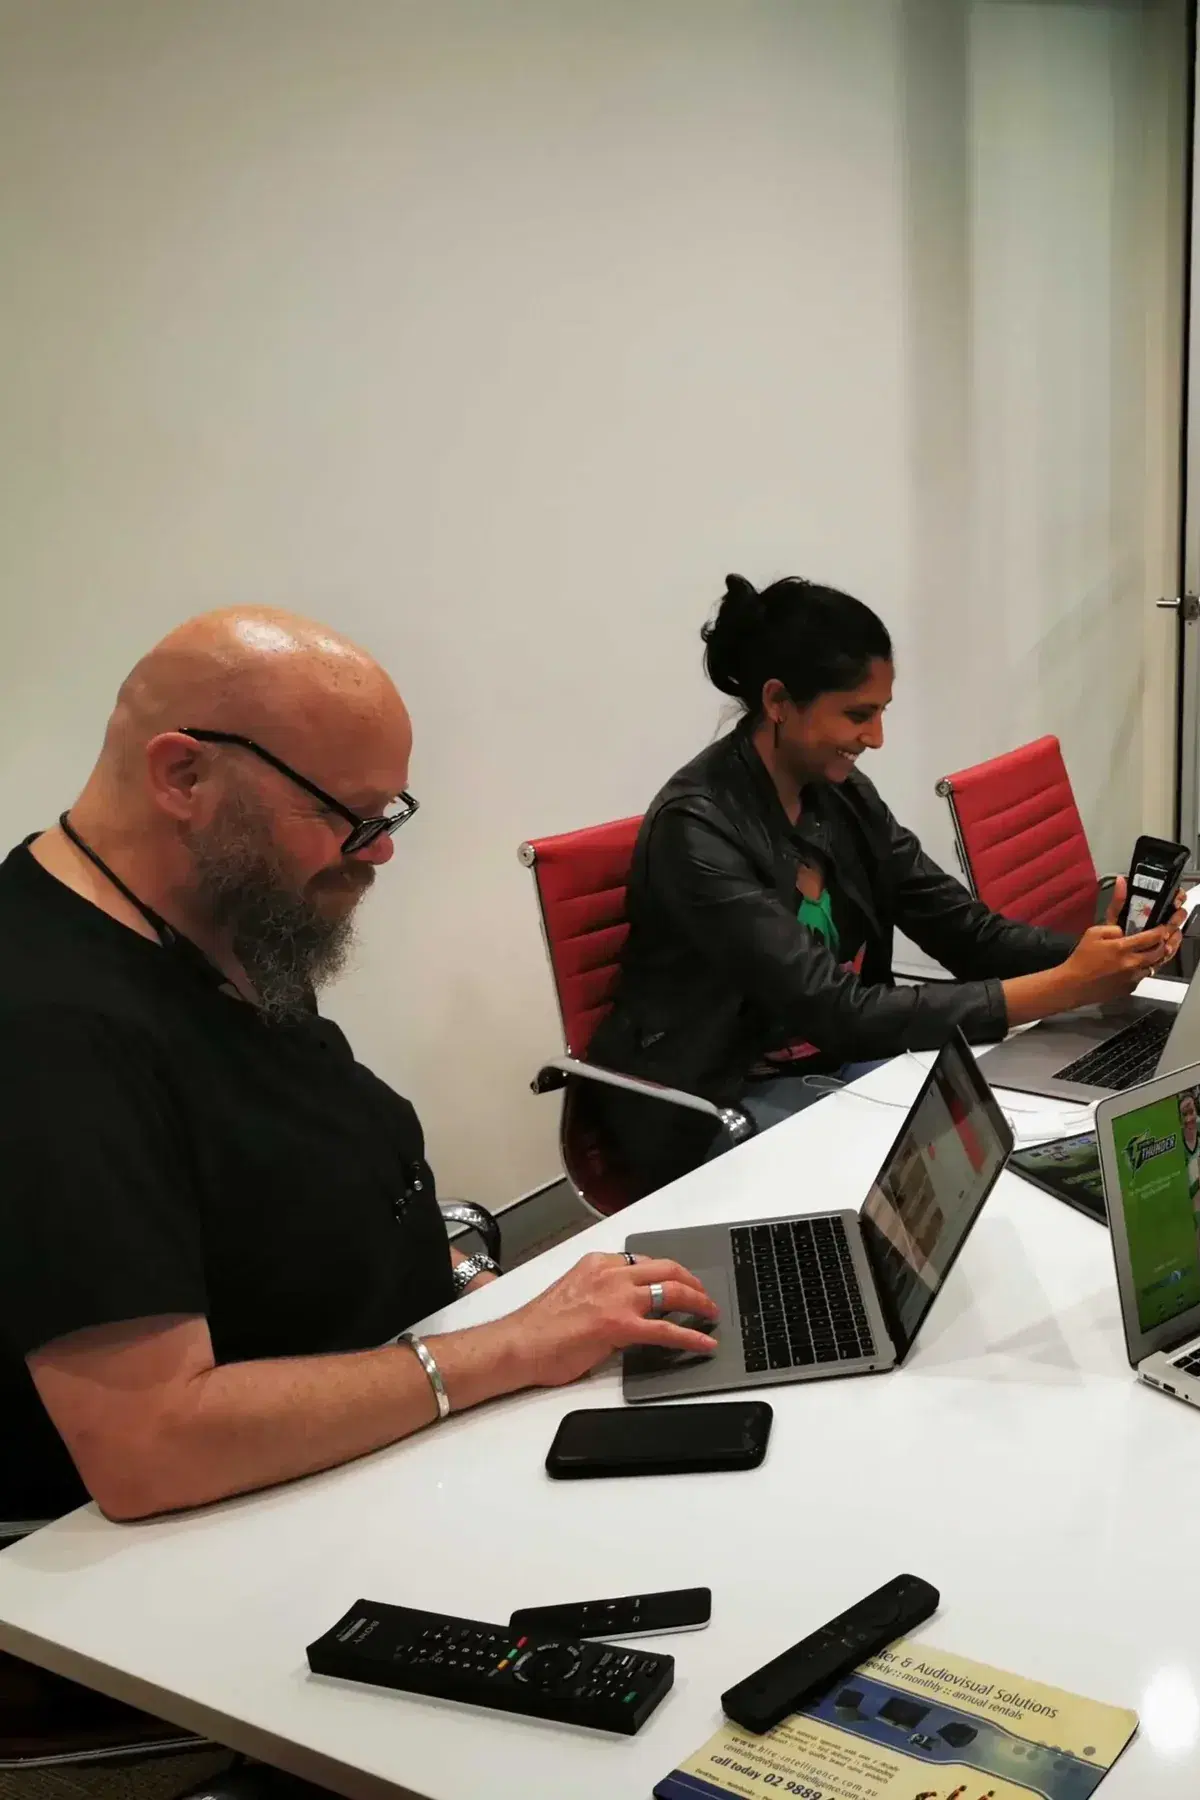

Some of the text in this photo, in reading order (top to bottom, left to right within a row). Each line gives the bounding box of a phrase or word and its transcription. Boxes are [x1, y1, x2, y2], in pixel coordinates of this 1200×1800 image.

[1142, 1136, 1175, 1160] THUNDER
[865, 1660, 893, 1676] eekly
[901, 1672, 944, 1694] monthly
[952, 1690, 988, 1708] annual
[988, 1702, 1024, 1721] rentals
[879, 1649, 1060, 1719] ter & Audiovisual Solutions
[710, 1755, 823, 1800] call today 02 9889
